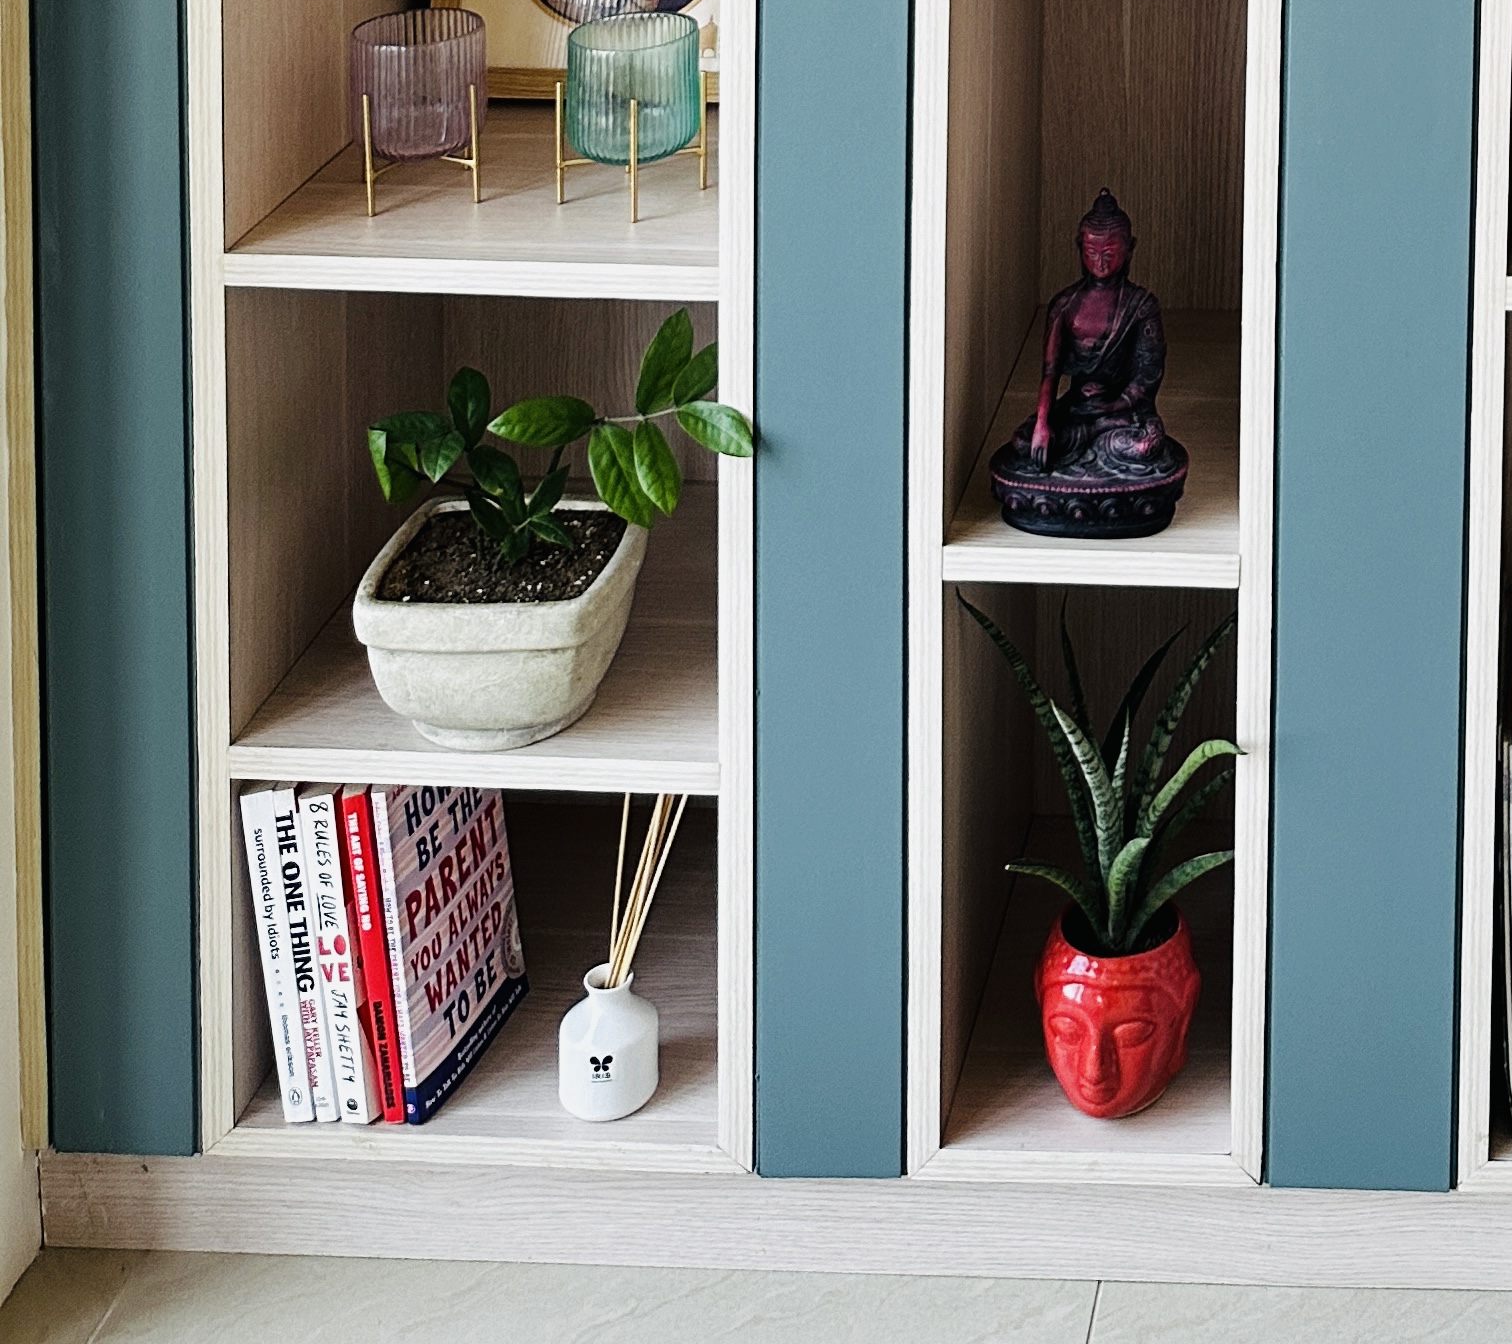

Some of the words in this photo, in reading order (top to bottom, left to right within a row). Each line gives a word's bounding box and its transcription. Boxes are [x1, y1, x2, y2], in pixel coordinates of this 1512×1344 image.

[309, 802, 329, 813] 8
[347, 812, 359, 833] THE
[275, 809, 298, 855] THE
[313, 819, 332, 866] RULES
[350, 835, 363, 856] ART
[416, 820, 442, 872] BE
[448, 787, 483, 836] THE
[254, 828, 275, 902] surrounded
[319, 873, 334, 889] OF
[353, 858, 365, 872] OF
[405, 797, 498, 944] PARENT
[282, 861, 305, 913] ONE
[355, 873, 370, 913] SAYING
[262, 904, 276, 921] by
[321, 894, 339, 929] LOVE
[361, 914, 373, 931] NO
[410, 931, 443, 982] YOU
[449, 851, 505, 947] ALWAYS
[267, 923, 281, 960] Idiots
[289, 917, 314, 993] THING
[424, 901, 502, 1015] WANTED
[307, 998, 318, 1024] GARY
[331, 989, 349, 1019] JAY
[443, 990, 470, 1040] TO
[474, 948, 498, 1004] BE
[281, 1015, 290, 1045] thomas
[311, 1028, 322, 1058] KELLER
[306, 1044, 320, 1088] PAPASAN
[335, 1024, 356, 1084] SHETTY
